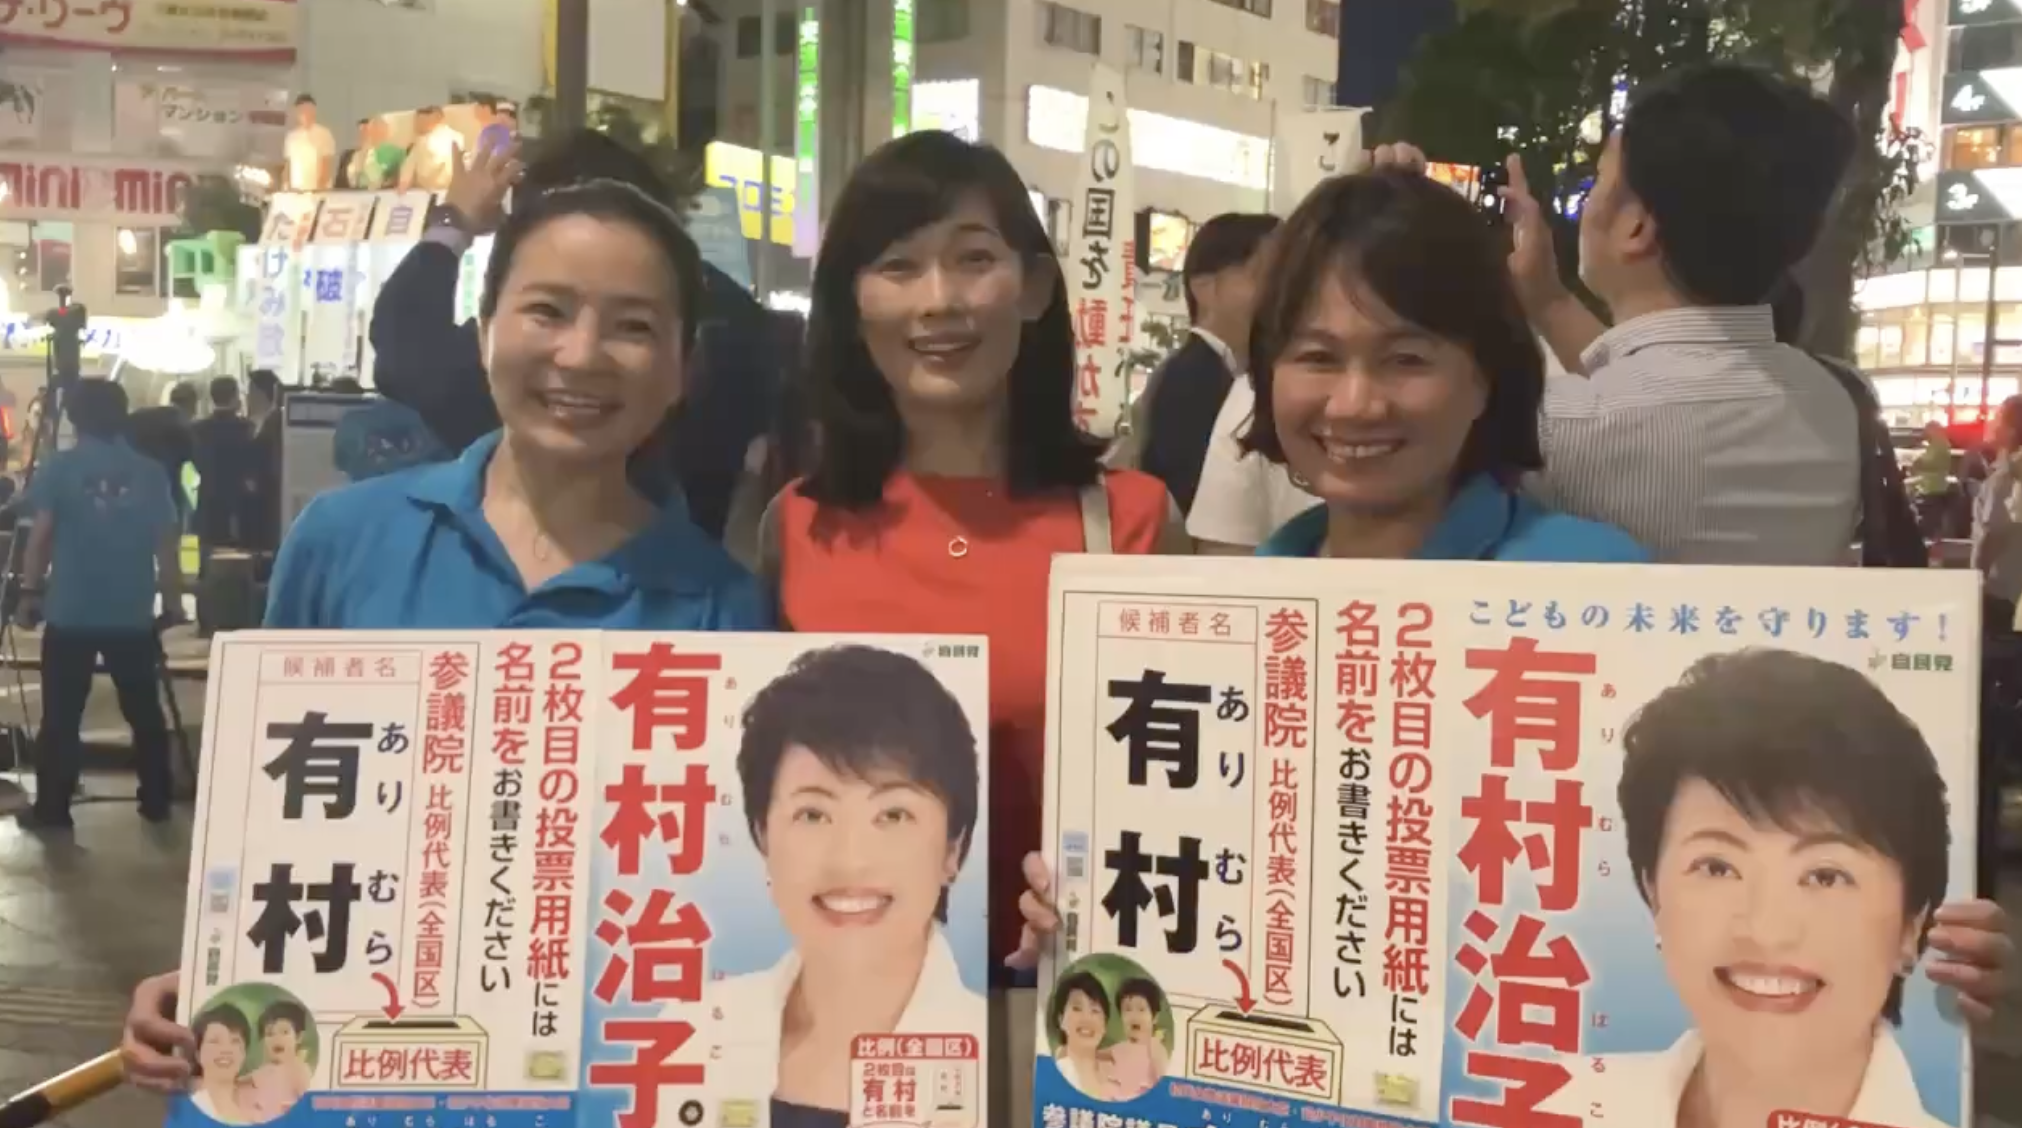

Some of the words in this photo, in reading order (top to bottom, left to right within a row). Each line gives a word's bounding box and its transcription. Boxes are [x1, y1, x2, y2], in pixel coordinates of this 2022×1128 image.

[114, 168, 192, 214] min
[283, 656, 397, 678] 候補者名
[1118, 608, 1232, 637] 候補者名
[1263, 608, 1308, 749] 参議院
[1469, 600, 1949, 641] こどもの未来を守ります！
[423, 650, 469, 774] 参議院
[1333, 602, 1380, 999] 名前をお書きください
[247, 711, 373, 973] 有村
[411, 785, 452, 1008] 比例代表（全国区）
[481, 643, 535, 992] 名前をお書きください
[527, 643, 584, 1036] 2枚目の投票用紙には
[1101, 669, 1212, 954] 有村
[1263, 759, 1298, 1006] 比例代表（全国区）
[1382, 602, 1436, 1057] 2枚目の投票用紙には
[344, 1049, 472, 1081] 比例代表
[1198, 1037, 1328, 1091] 比例代表
